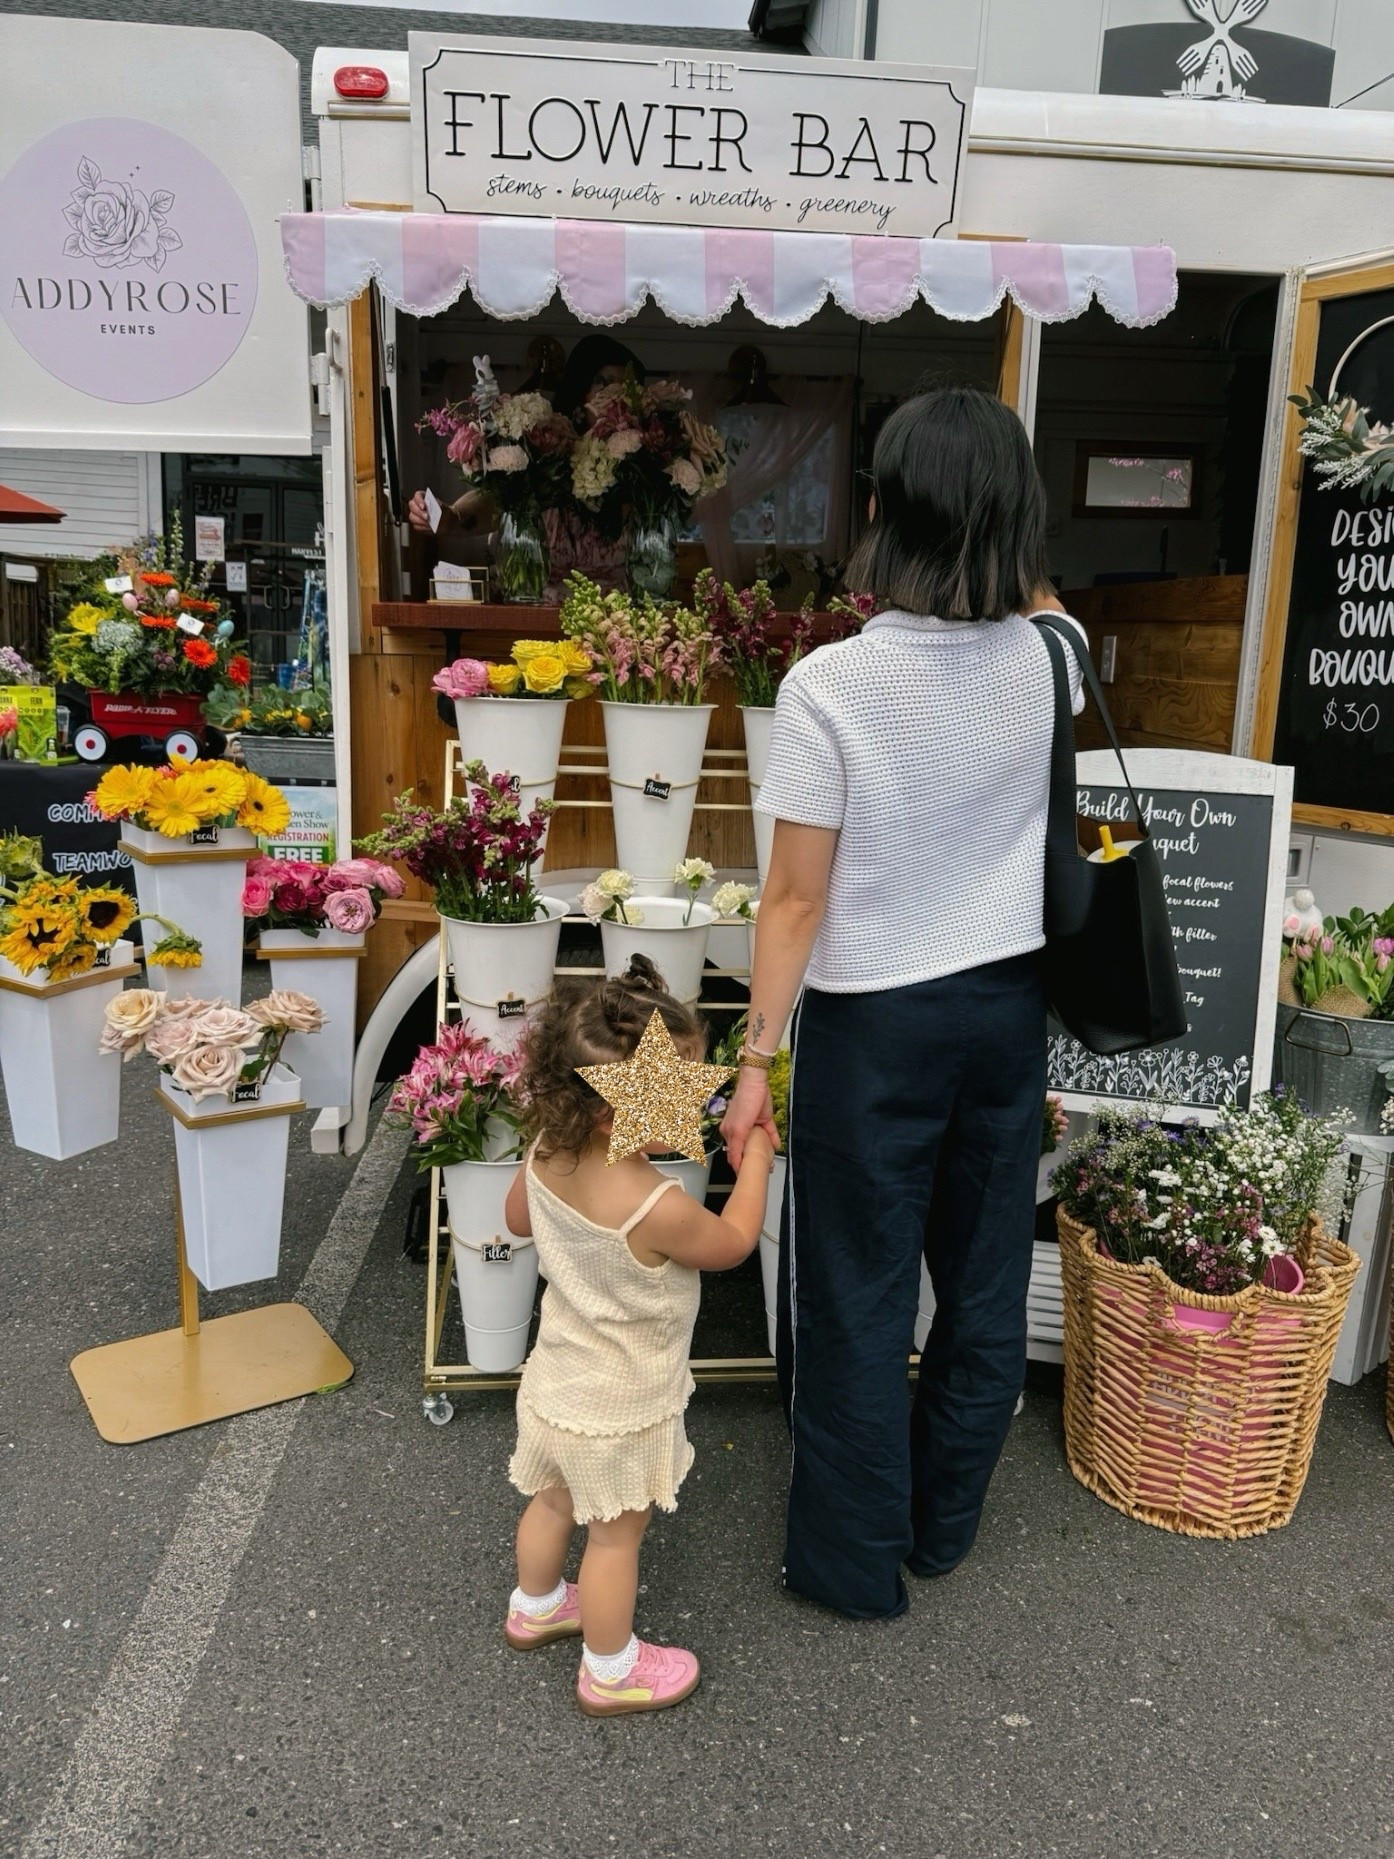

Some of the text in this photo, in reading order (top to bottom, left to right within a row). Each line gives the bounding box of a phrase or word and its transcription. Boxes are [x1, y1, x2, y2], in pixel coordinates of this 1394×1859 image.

[664, 59, 734, 92] THE
[443, 91, 938, 184] FLOWER BAR
[486, 173, 897, 230] stems bouquets wreaths greenery
[11, 277, 242, 315] ADDYROSE
[100, 324, 156, 336] EVENTS
[1337, 552, 1394, 596] YOU
[1308, 648, 1394, 688] BOUQU
[1322, 697, 1380, 733] $30
[290, 809, 315, 819] ower
[1076, 790, 1237, 829] Build Your Own
[303, 818, 328, 829] Show
[53, 850, 132, 873] TEAMWO
[273, 846, 324, 863] FREE
[1162, 874, 1235, 893] focal flowers
[1164, 893, 1221, 909] ew accent
[1185, 926, 1218, 944] filler
[1184, 990, 1205, 1008] Tag
[483, 1244, 511, 1261] Filler
